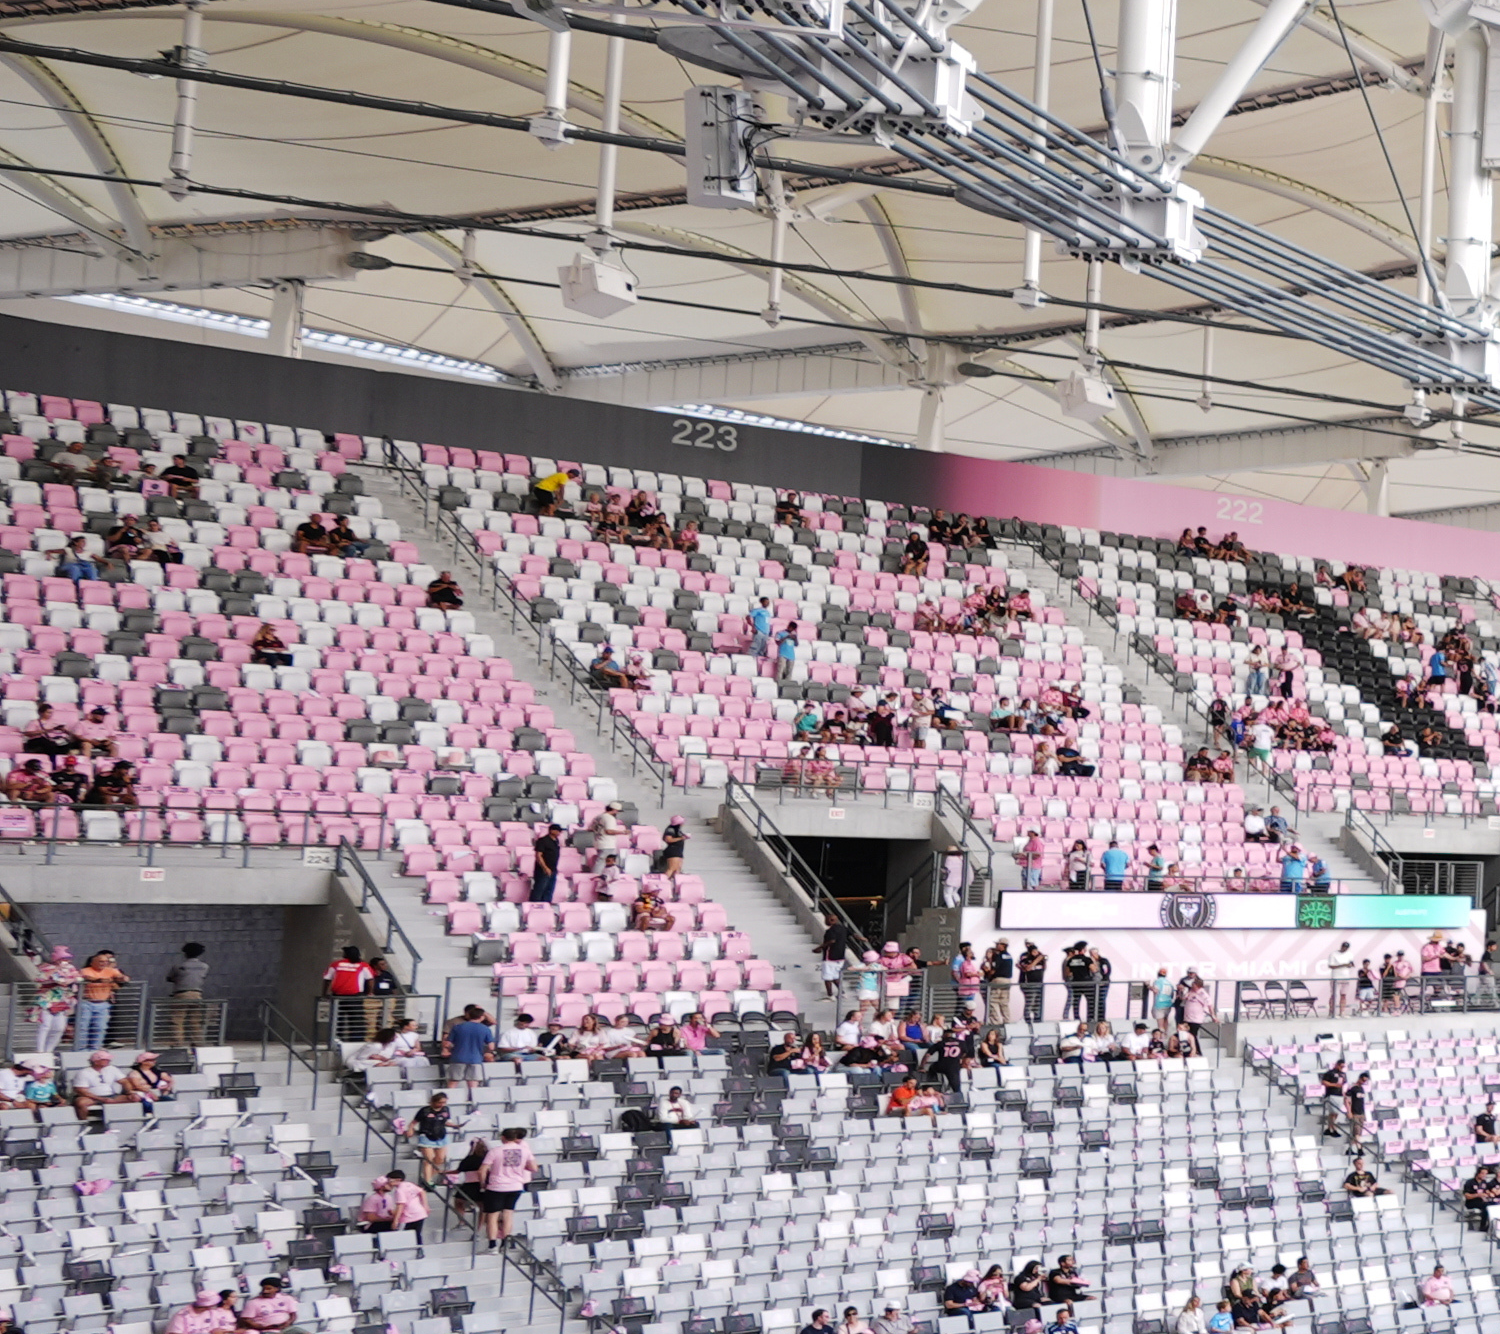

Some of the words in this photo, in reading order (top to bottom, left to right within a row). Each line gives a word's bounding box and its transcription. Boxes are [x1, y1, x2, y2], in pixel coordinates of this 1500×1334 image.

[671, 419, 738, 452] 223
[1215, 496, 1264, 525] 222
[306, 855, 331, 865] 224
[1225, 959, 1308, 977] MIAMI
